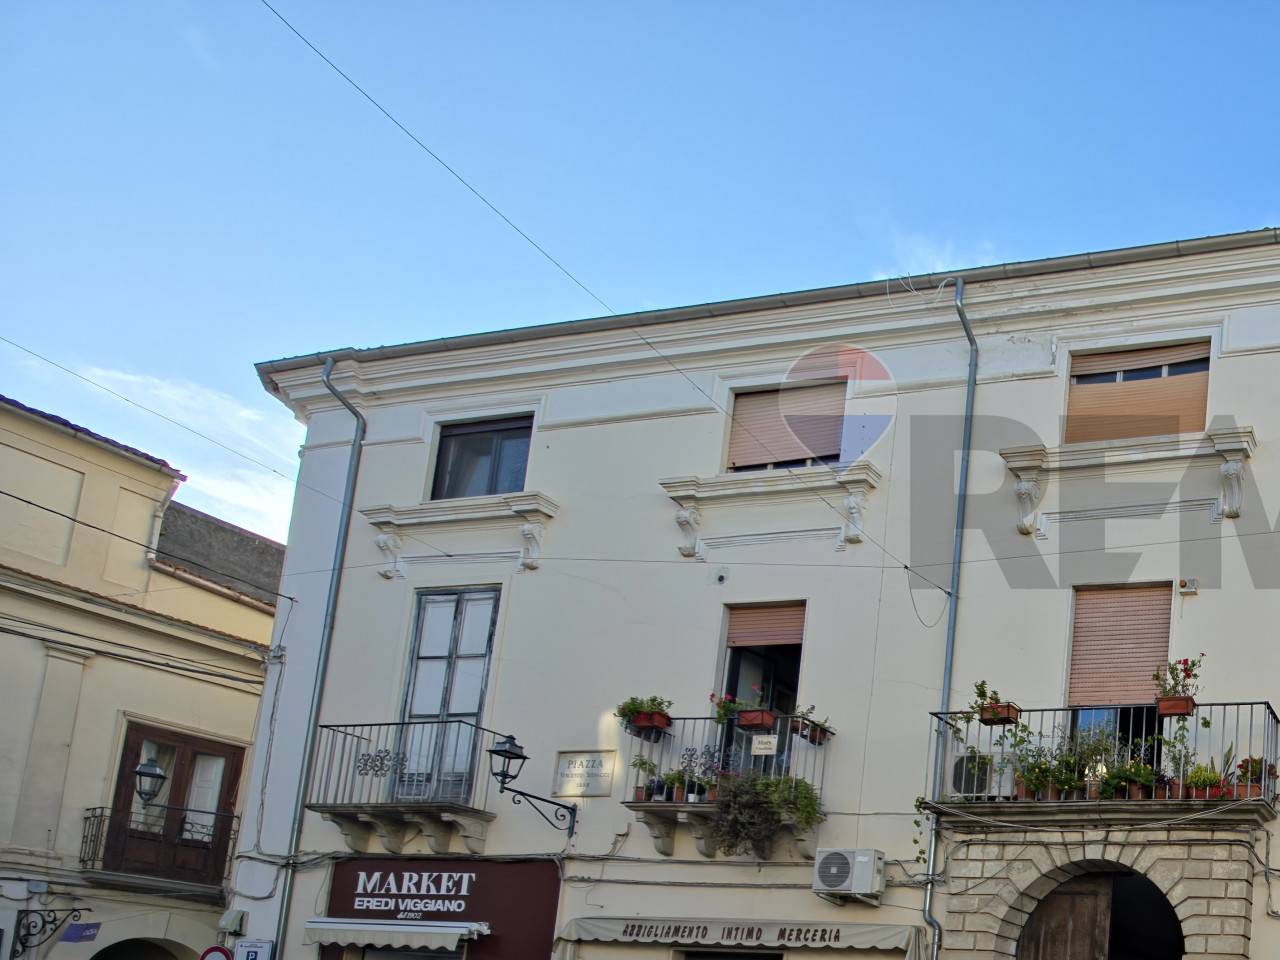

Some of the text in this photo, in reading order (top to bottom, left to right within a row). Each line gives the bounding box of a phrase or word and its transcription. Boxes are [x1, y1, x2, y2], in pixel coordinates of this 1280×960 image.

[567, 759, 603, 769] PIAZZA
[354, 871, 476, 895] MARKET
[354, 897, 466, 912] EREDI VIGGIANO
[622, 923, 841, 943] ABBIGLIAMENTO INTIMO MERCERIA
